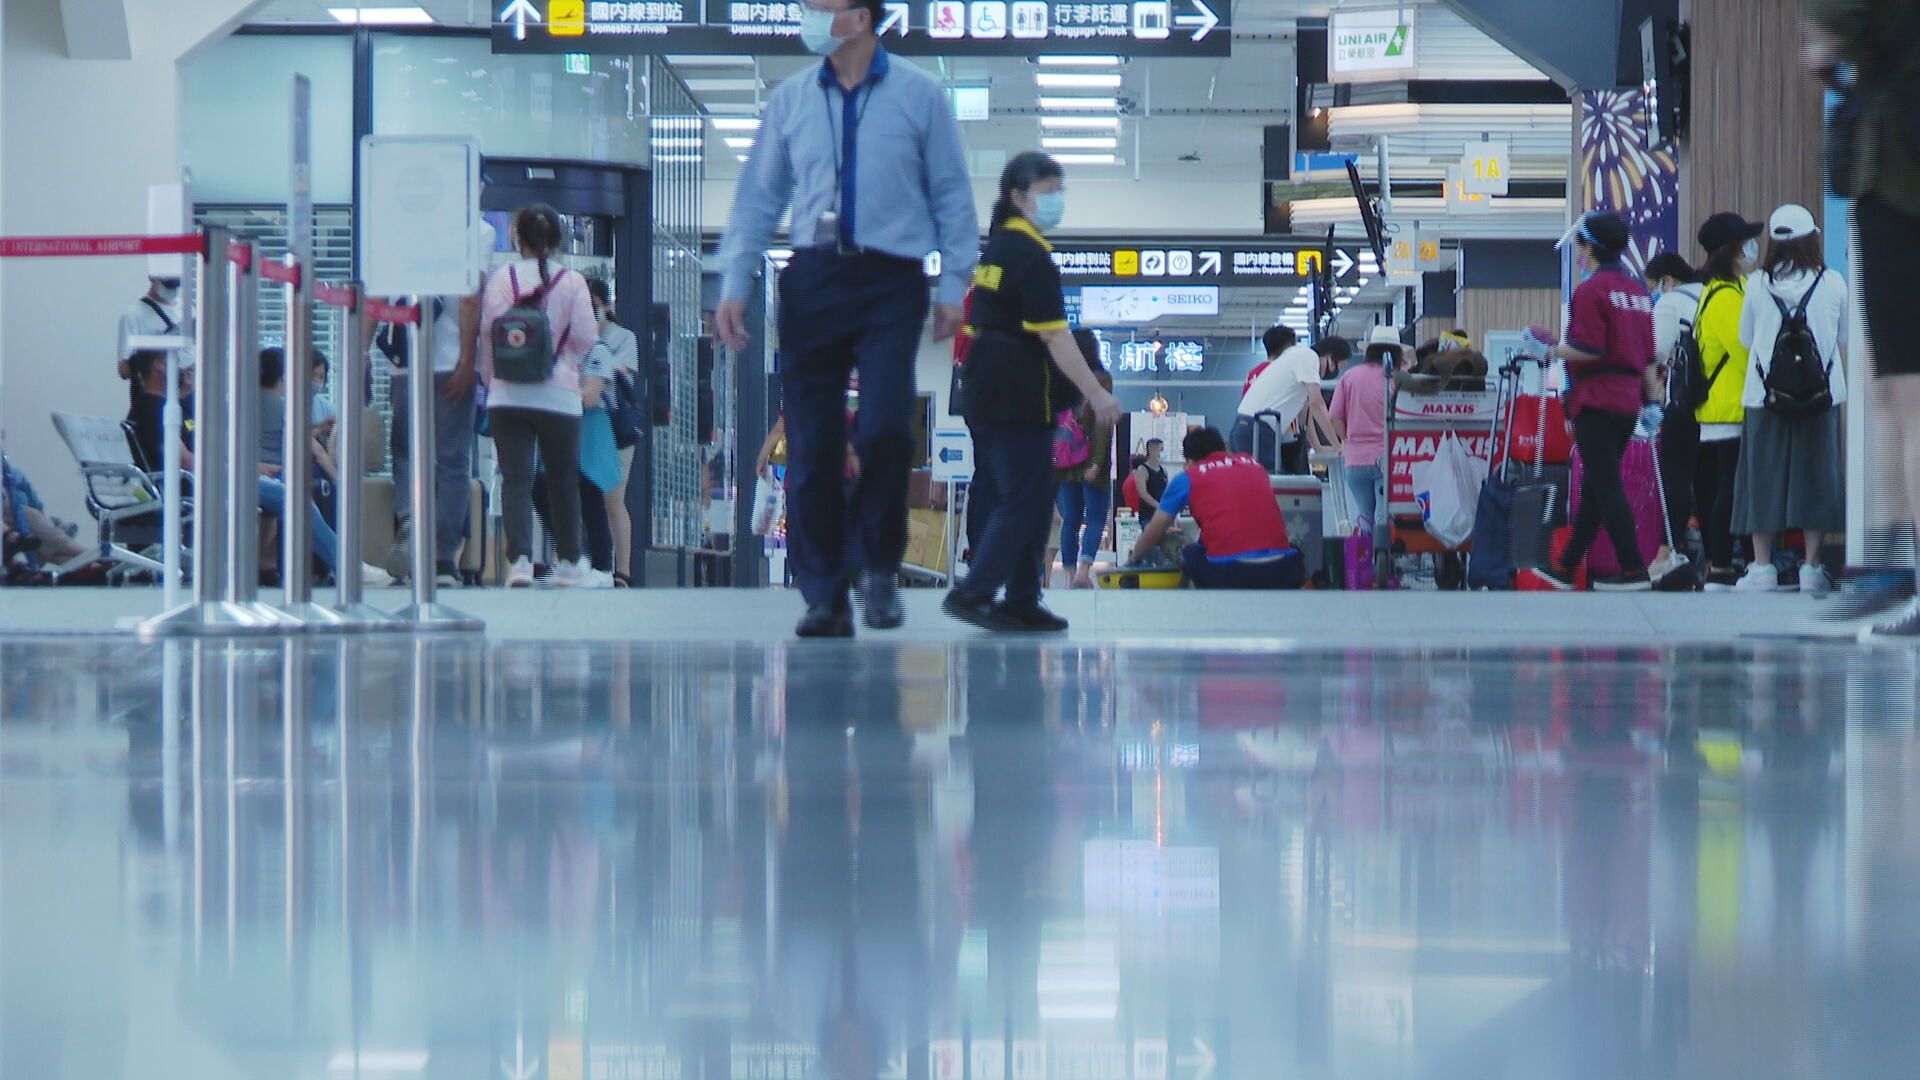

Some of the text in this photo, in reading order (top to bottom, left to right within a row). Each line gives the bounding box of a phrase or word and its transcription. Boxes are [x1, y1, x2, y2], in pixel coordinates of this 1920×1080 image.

[590, 2, 683, 21] 國內線到站
[1054, 3, 1129, 23] 行李託運
[590, 23, 669, 34] Domestic Arrivals
[731, 24, 773, 35] Domestic
[1054, 24, 1128, 38] Baggage Check
[1338, 33, 1387, 46] UNI AIR
[1472, 157, 1500, 179] 1A
[97, 239, 141, 251] AIRPORT
[1167, 294, 1213, 305] SEIKO
[1422, 403, 1475, 414] MAXXIS
